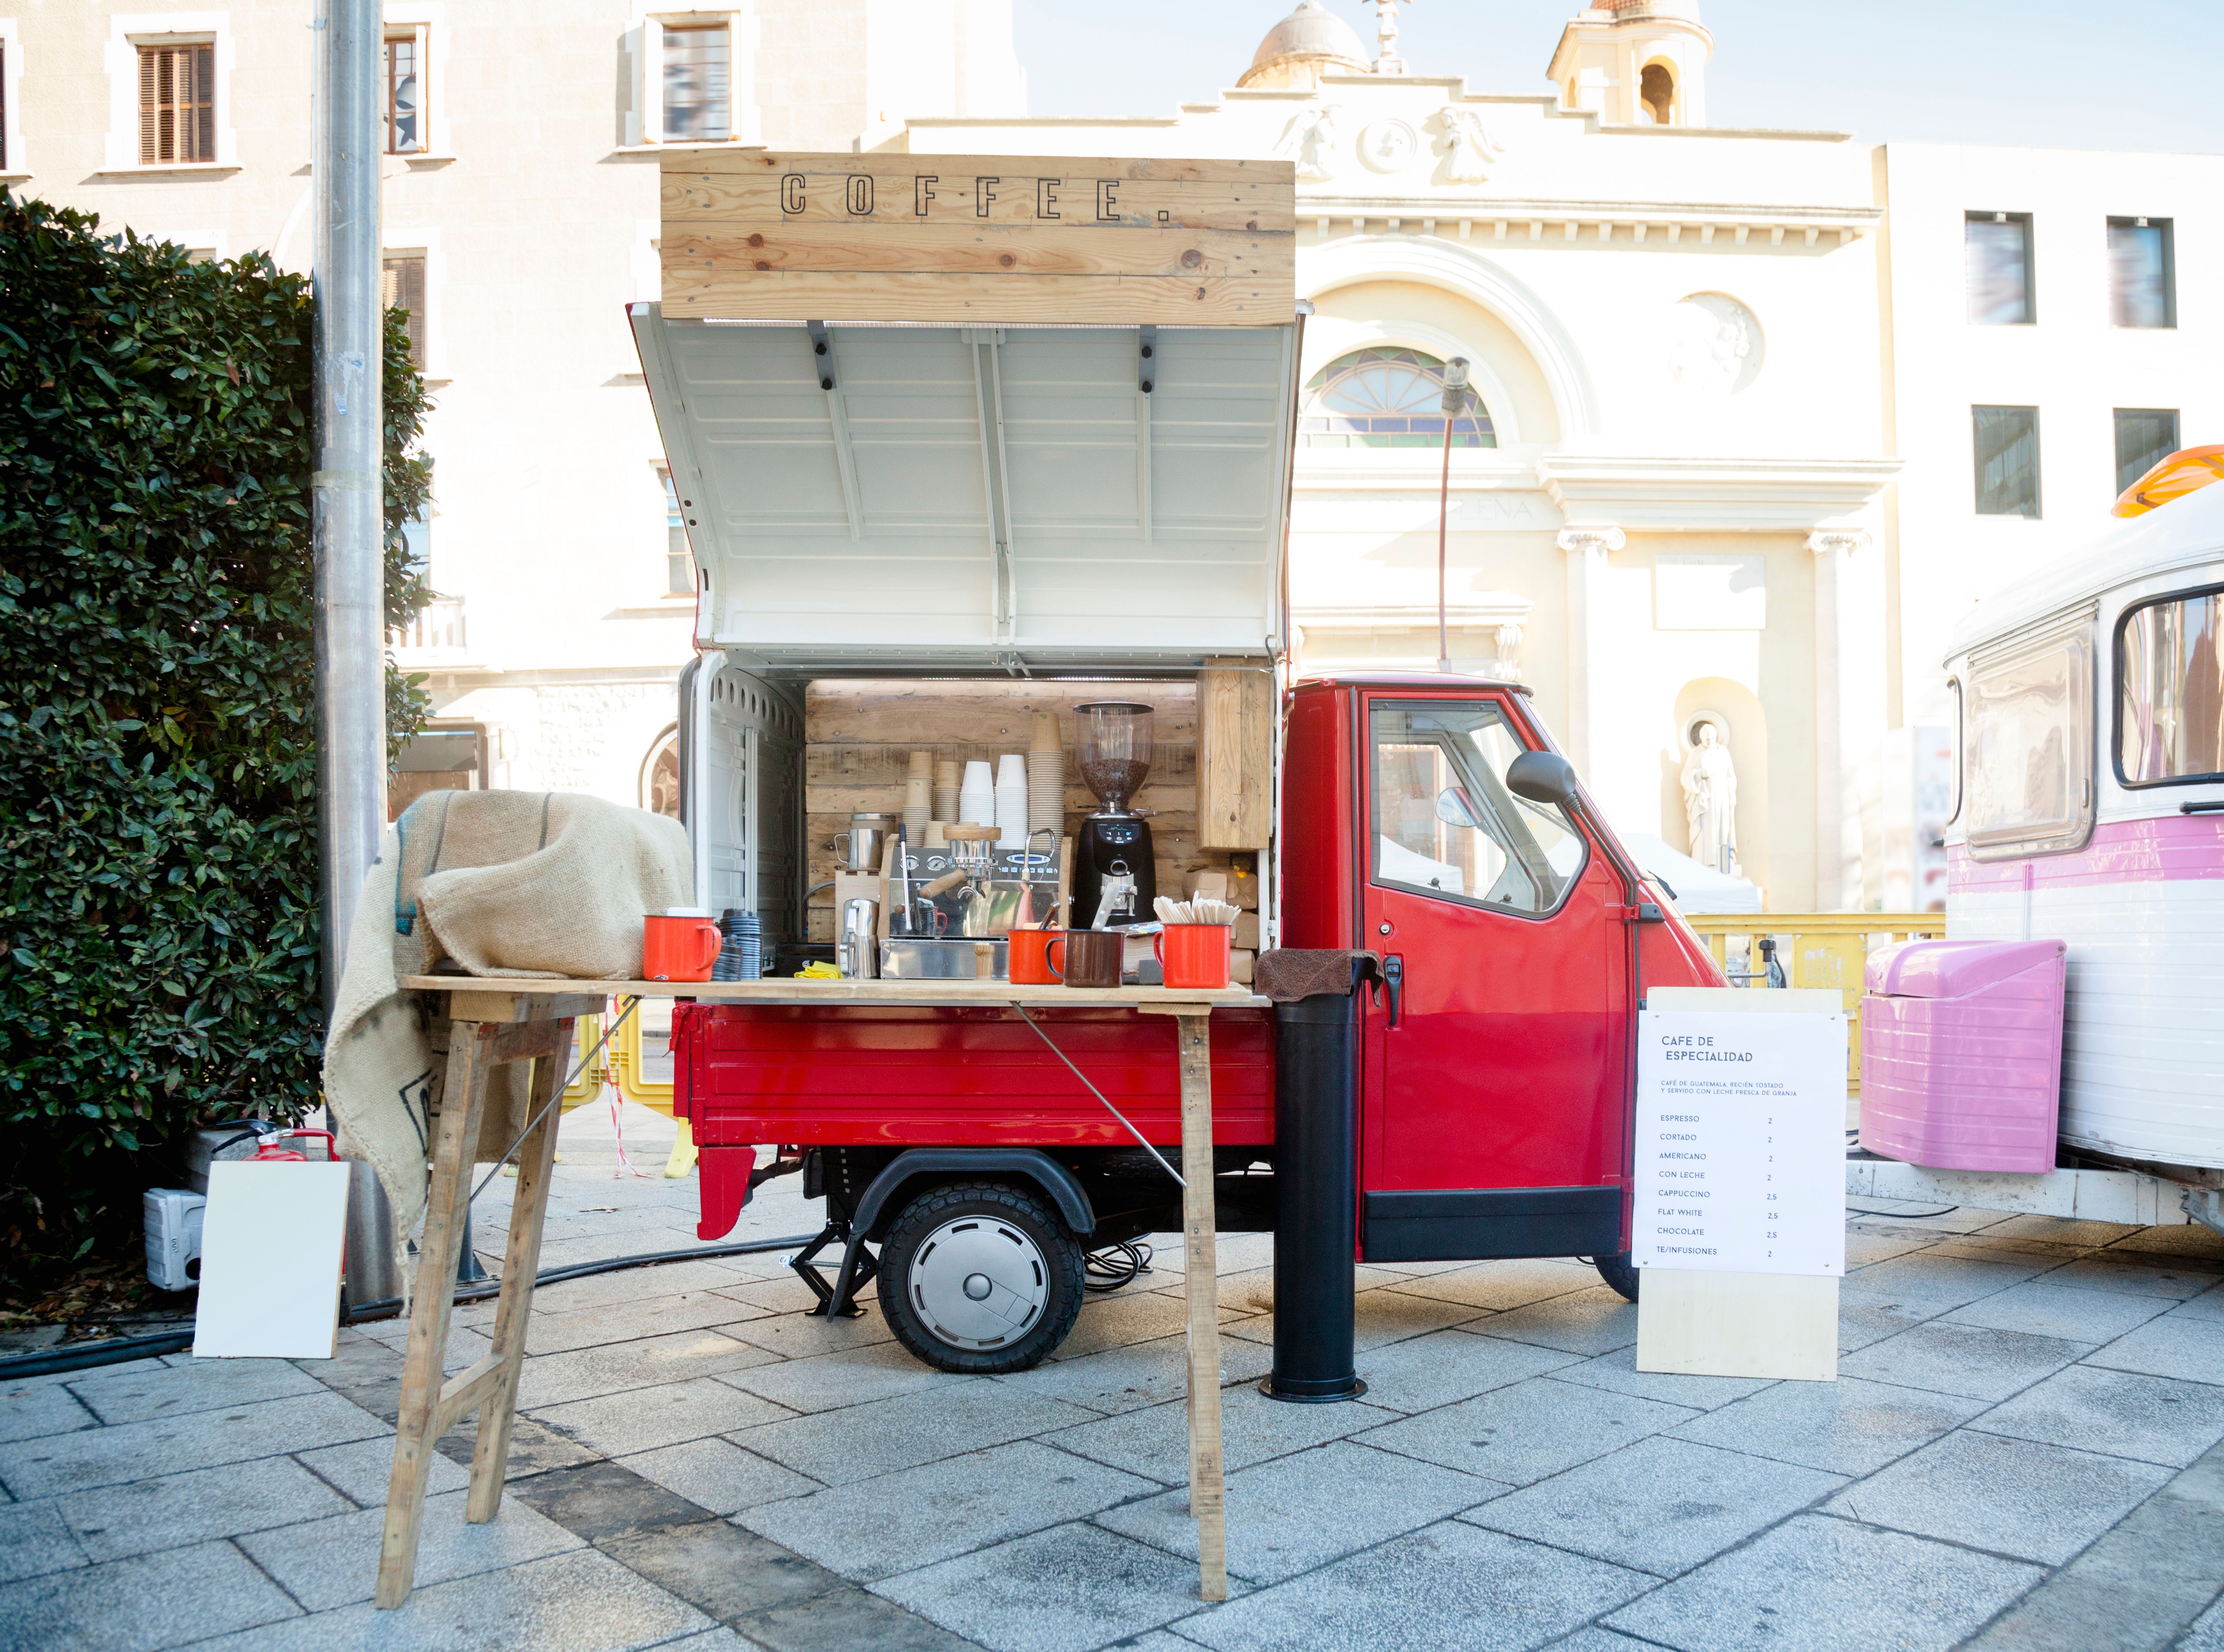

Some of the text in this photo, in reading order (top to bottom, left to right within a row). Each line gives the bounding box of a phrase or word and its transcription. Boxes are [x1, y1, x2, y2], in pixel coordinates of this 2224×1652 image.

[781, 173, 1169, 222] COFFEE.
[1661, 1036, 1713, 1046] CAFE DE
[1666, 1051, 1753, 1062] ESPECIALIDAD
[1657, 1227, 1704, 1235] CHOCOLATE
[1657, 1246, 1717, 1255] TE/INFUSIONES
